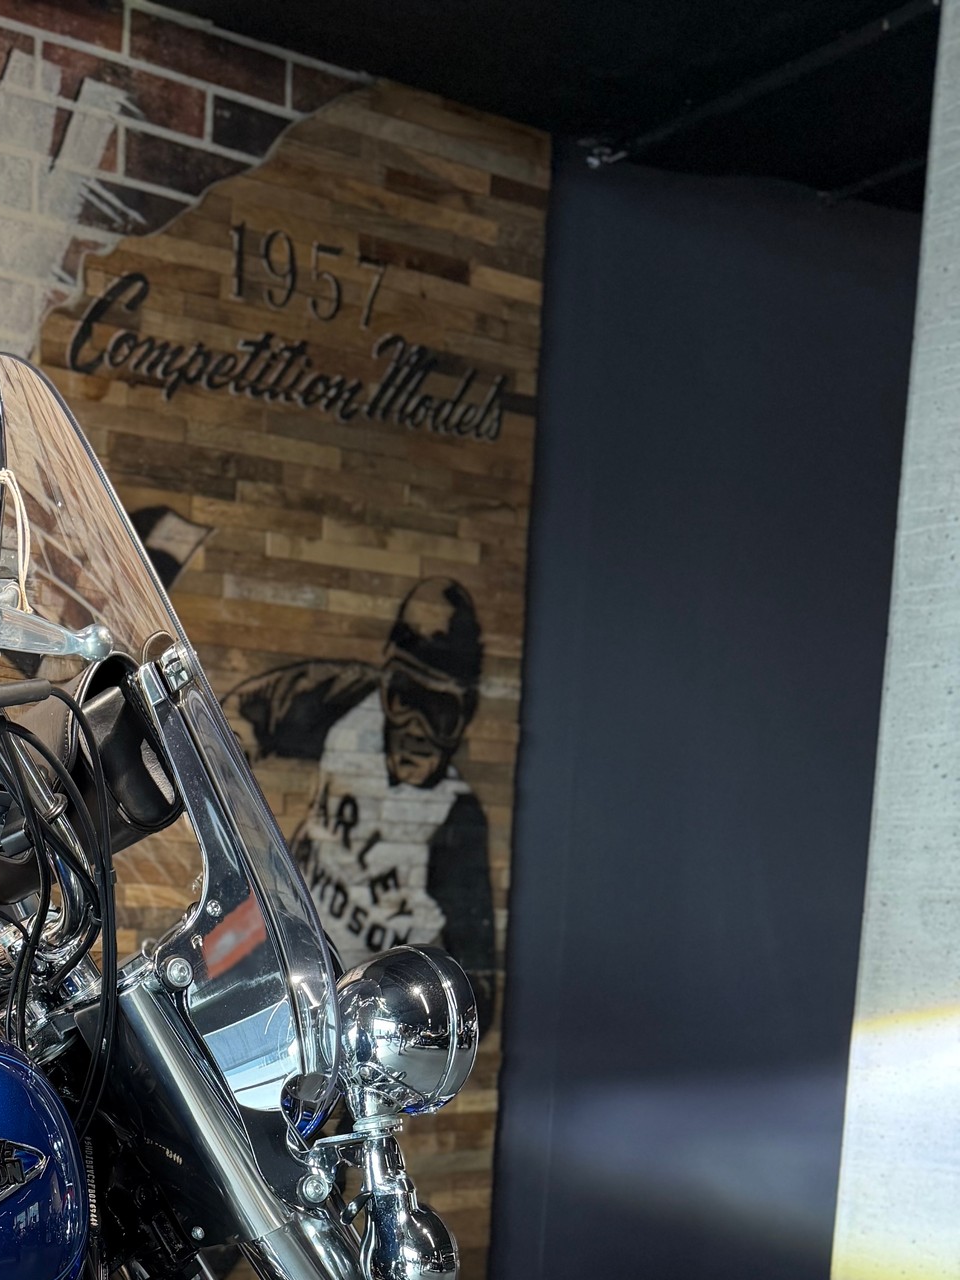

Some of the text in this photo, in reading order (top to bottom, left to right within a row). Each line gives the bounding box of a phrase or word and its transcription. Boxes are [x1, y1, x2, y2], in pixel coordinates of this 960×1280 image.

[229, 221, 388, 330] 1957
[68, 272, 509, 442] Competition Models
